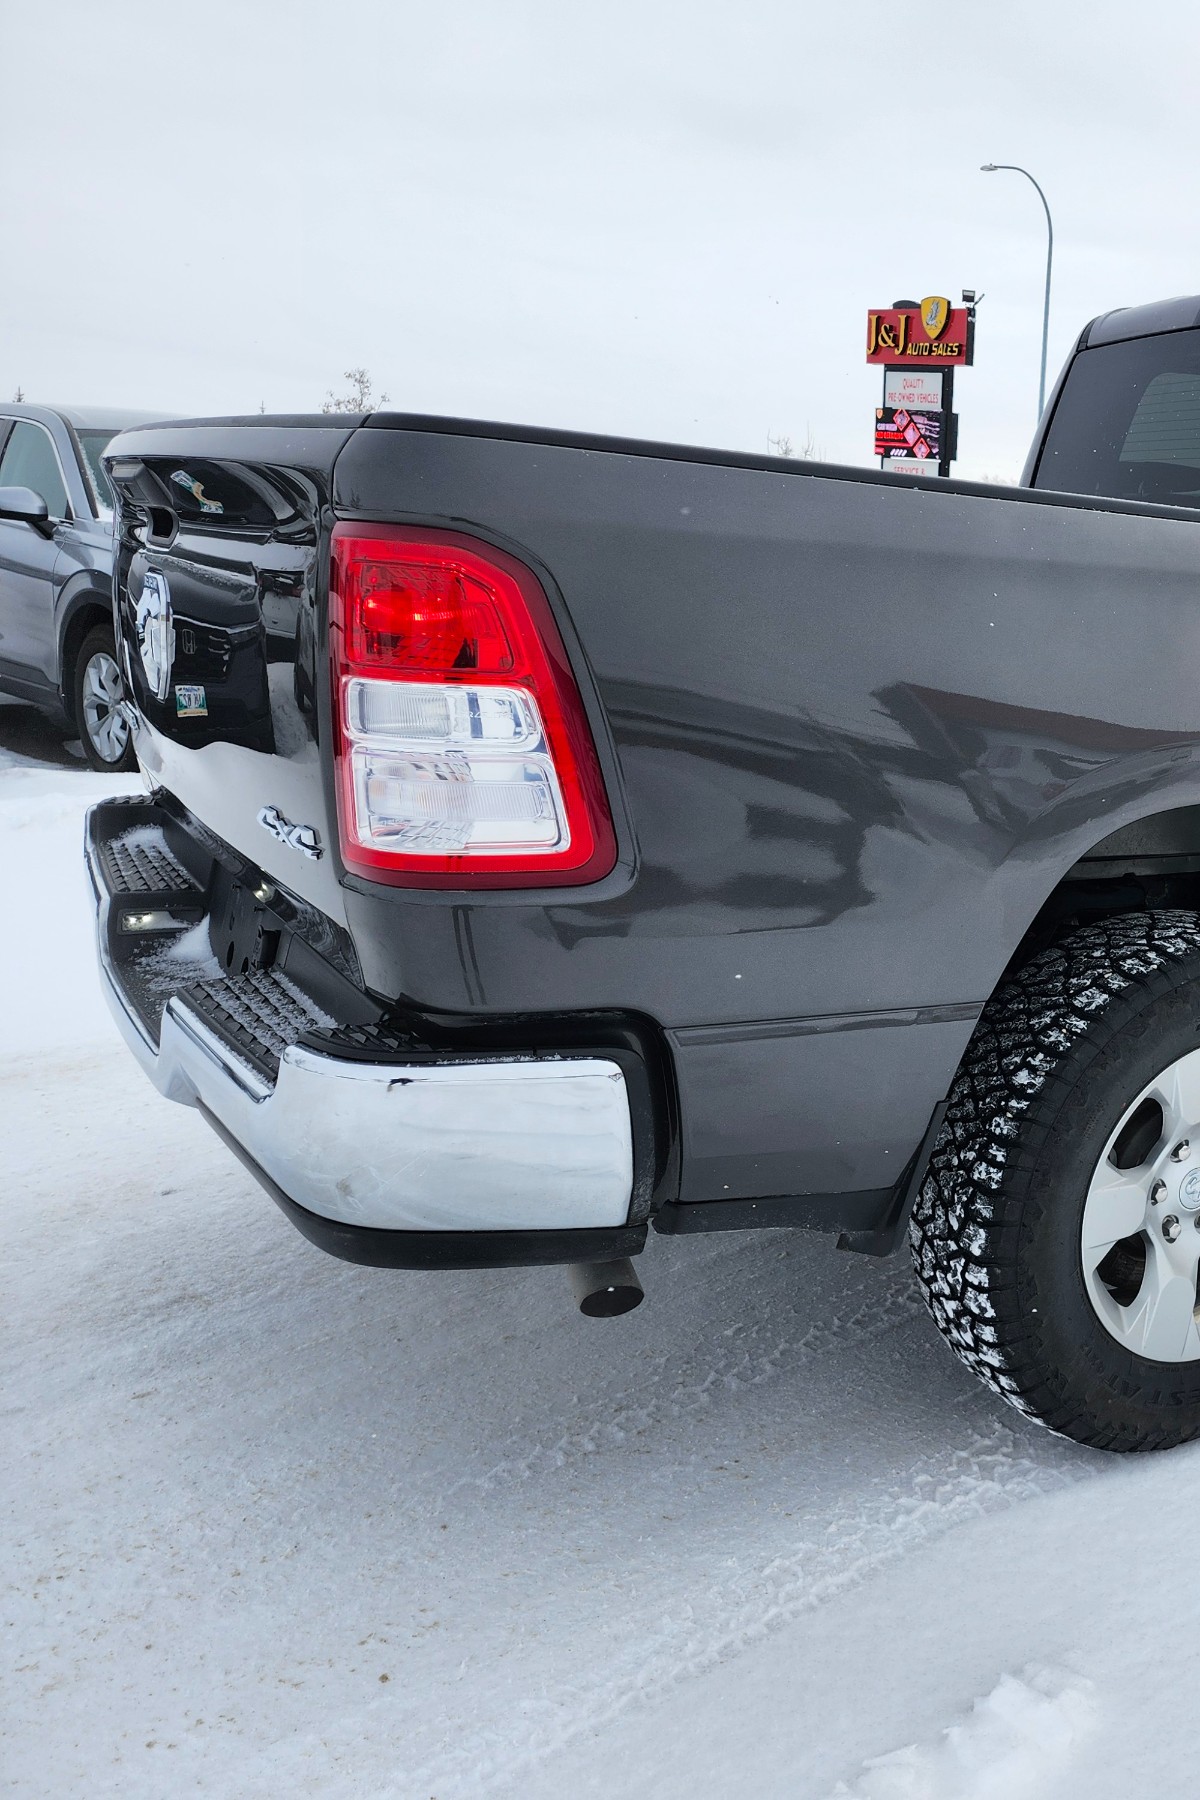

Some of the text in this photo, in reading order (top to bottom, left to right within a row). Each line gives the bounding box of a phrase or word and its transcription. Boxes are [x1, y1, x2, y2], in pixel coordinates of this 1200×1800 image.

[867, 314, 908, 355] J&J
[906, 342, 960, 357] AUTO SALES
